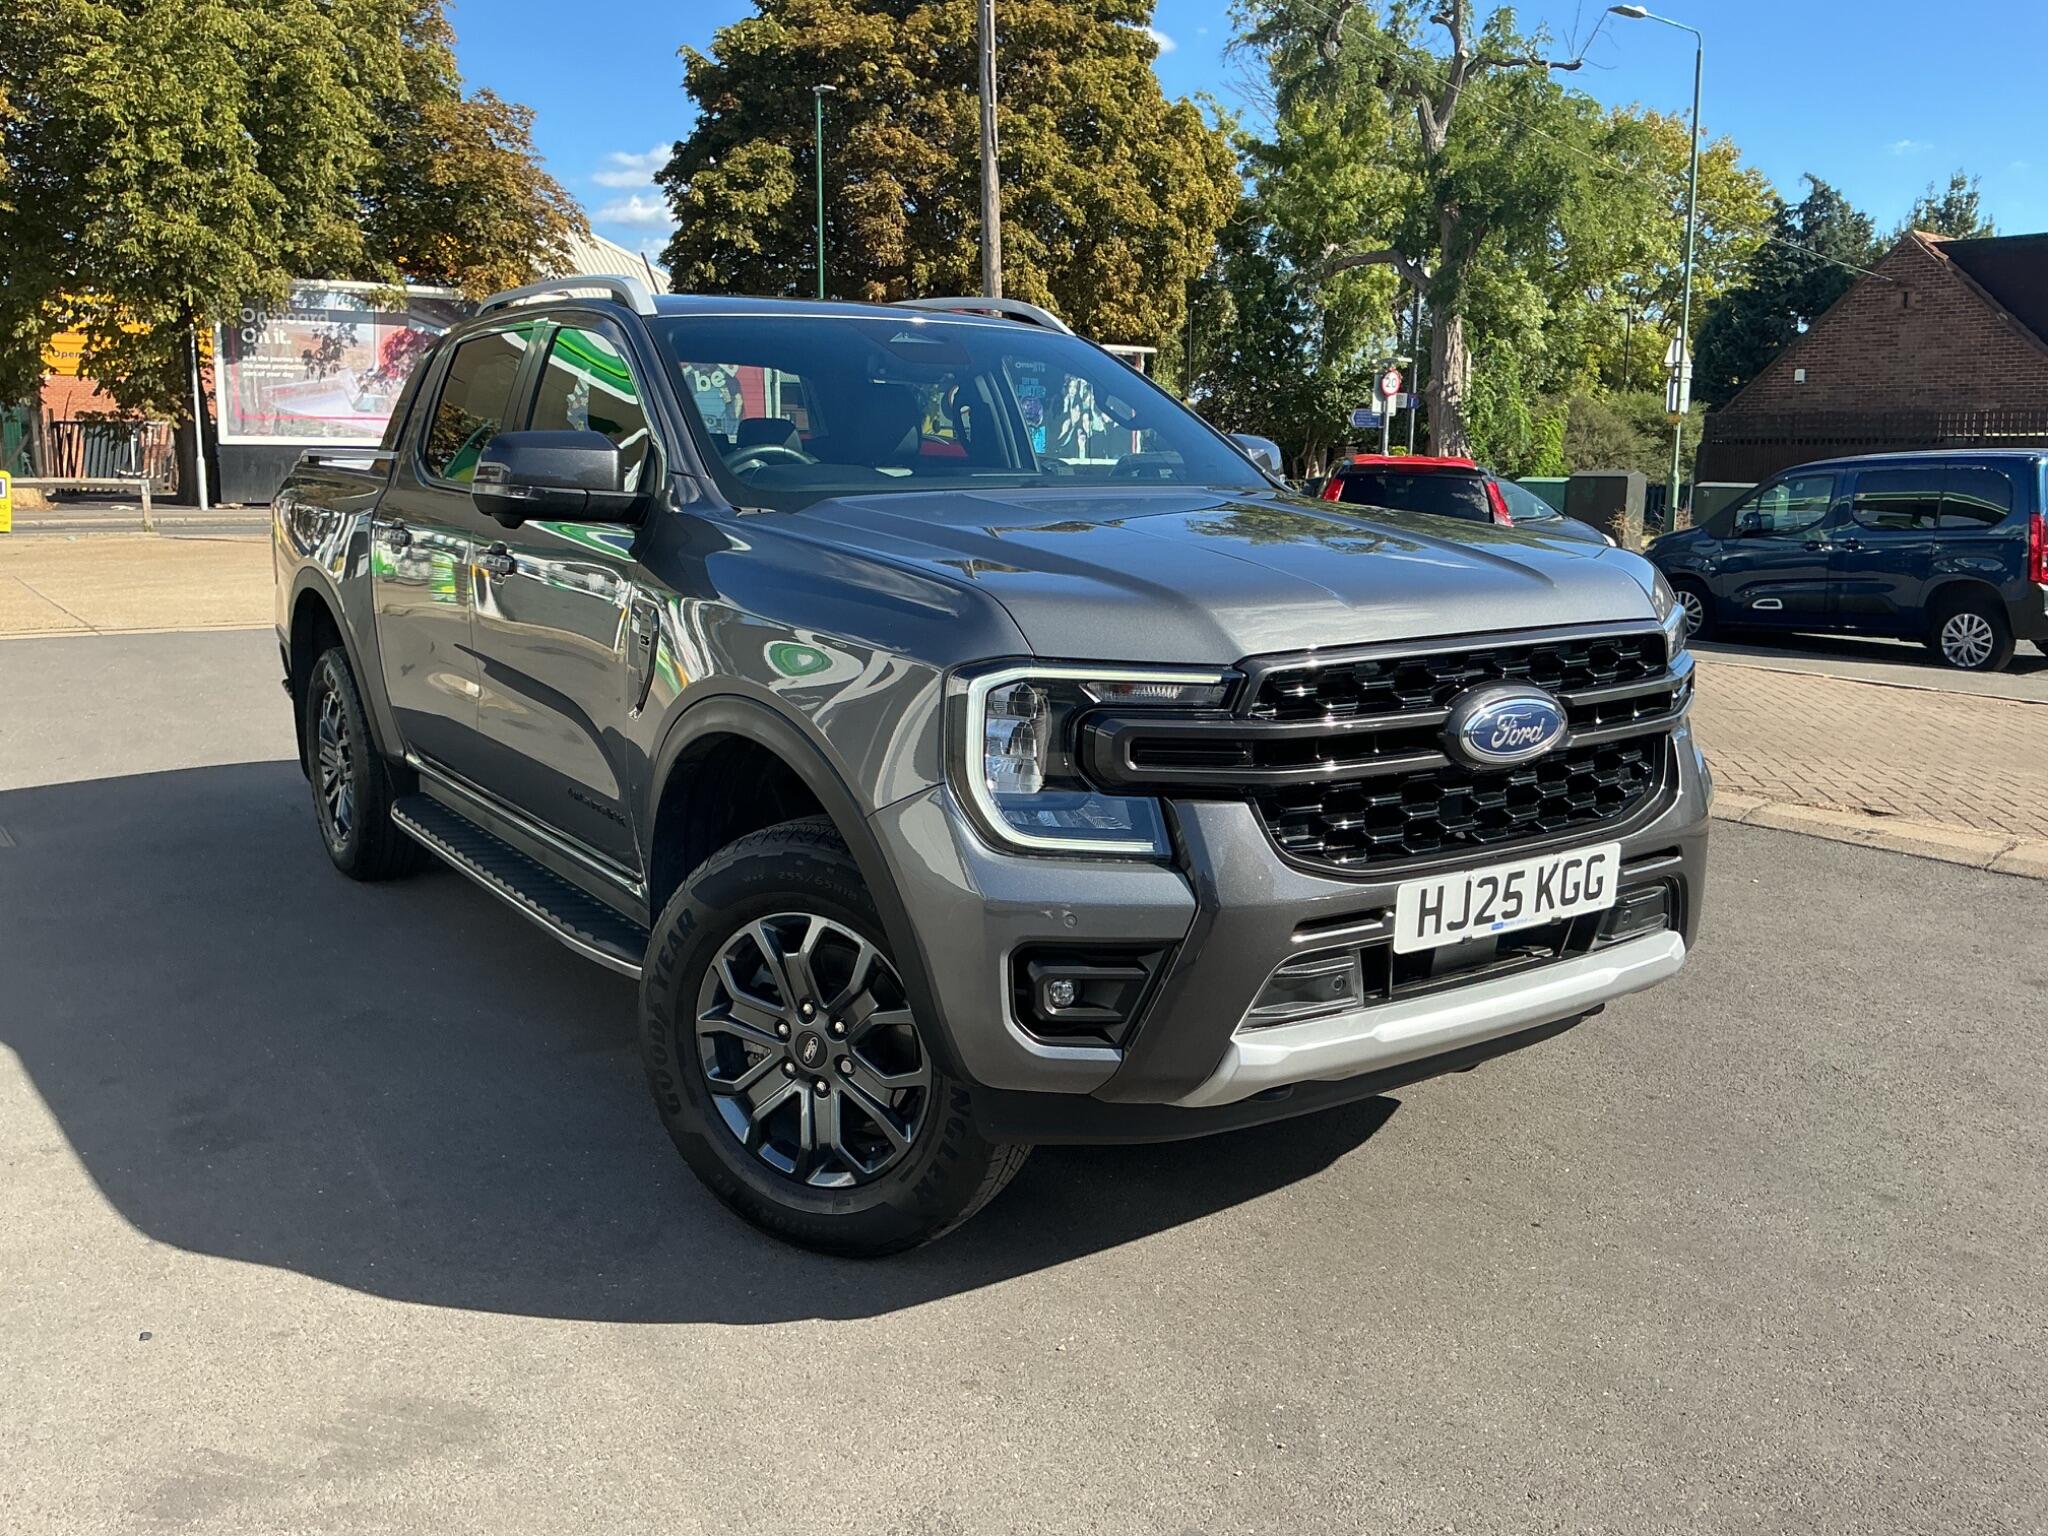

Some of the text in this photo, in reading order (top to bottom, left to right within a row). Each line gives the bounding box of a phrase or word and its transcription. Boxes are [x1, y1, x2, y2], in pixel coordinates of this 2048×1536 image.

[241, 307, 329, 323] On board
[242, 327, 292, 345] On it.
[52, 350, 81, 359] Open
[1385, 377, 1397, 388] 20
[1491, 712, 1545, 749] Ford
[1417, 853, 1606, 938] HJ25 KGG
